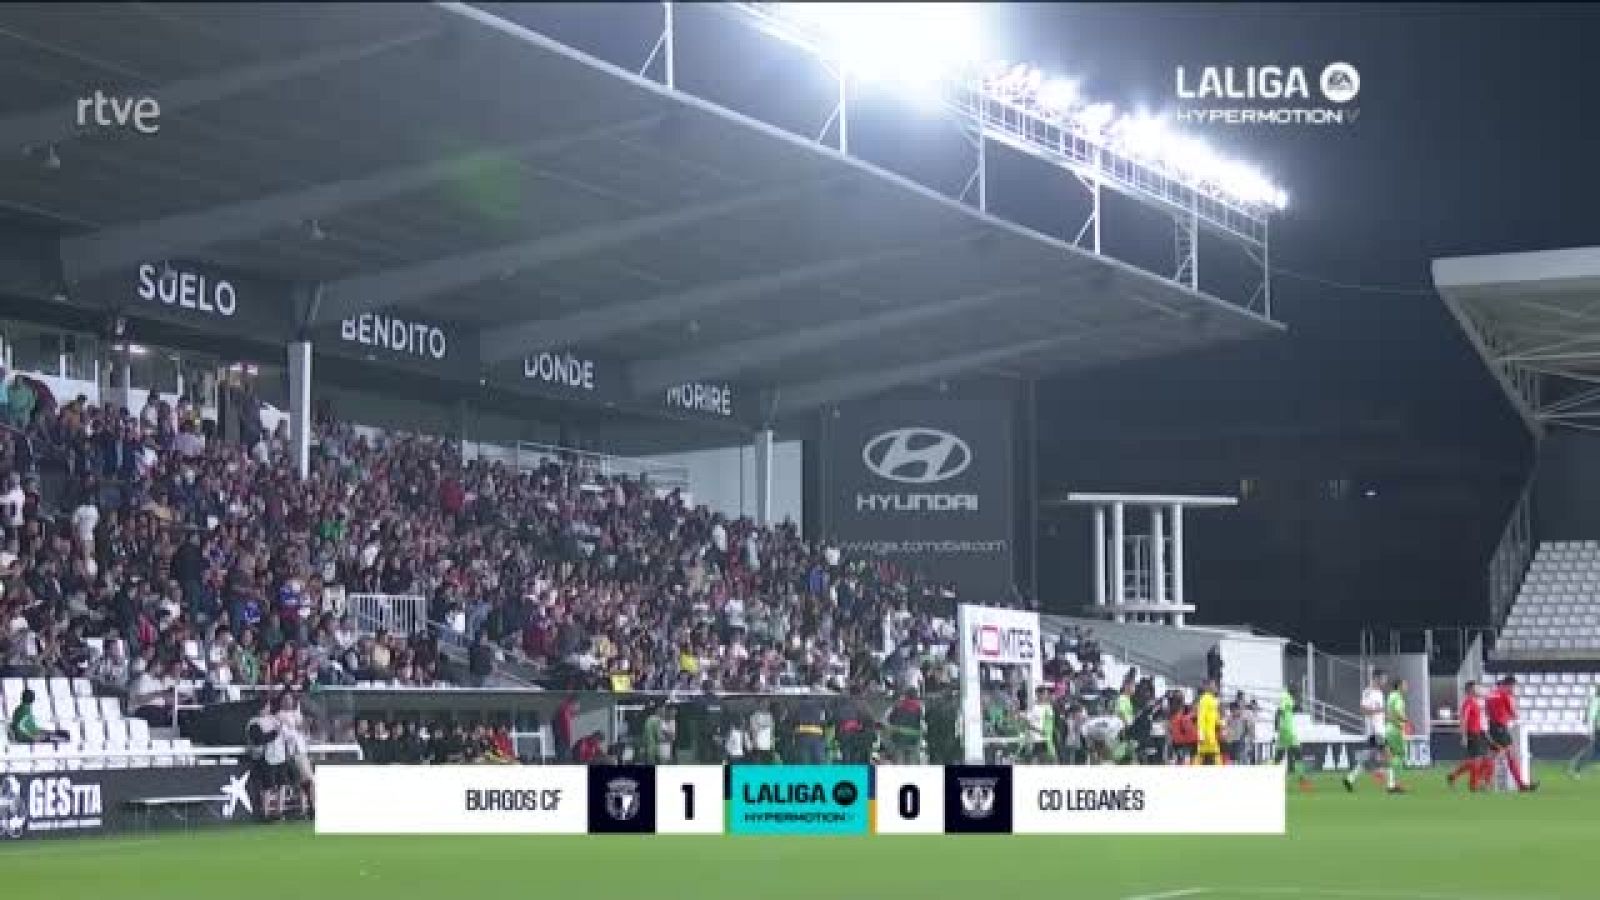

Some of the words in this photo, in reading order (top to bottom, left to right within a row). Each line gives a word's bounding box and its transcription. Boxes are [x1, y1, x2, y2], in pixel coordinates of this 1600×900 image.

[138, 263, 237, 317] SUELO
[341, 312, 447, 359] BENDITO
[856, 494, 979, 512] HYUNDAI
